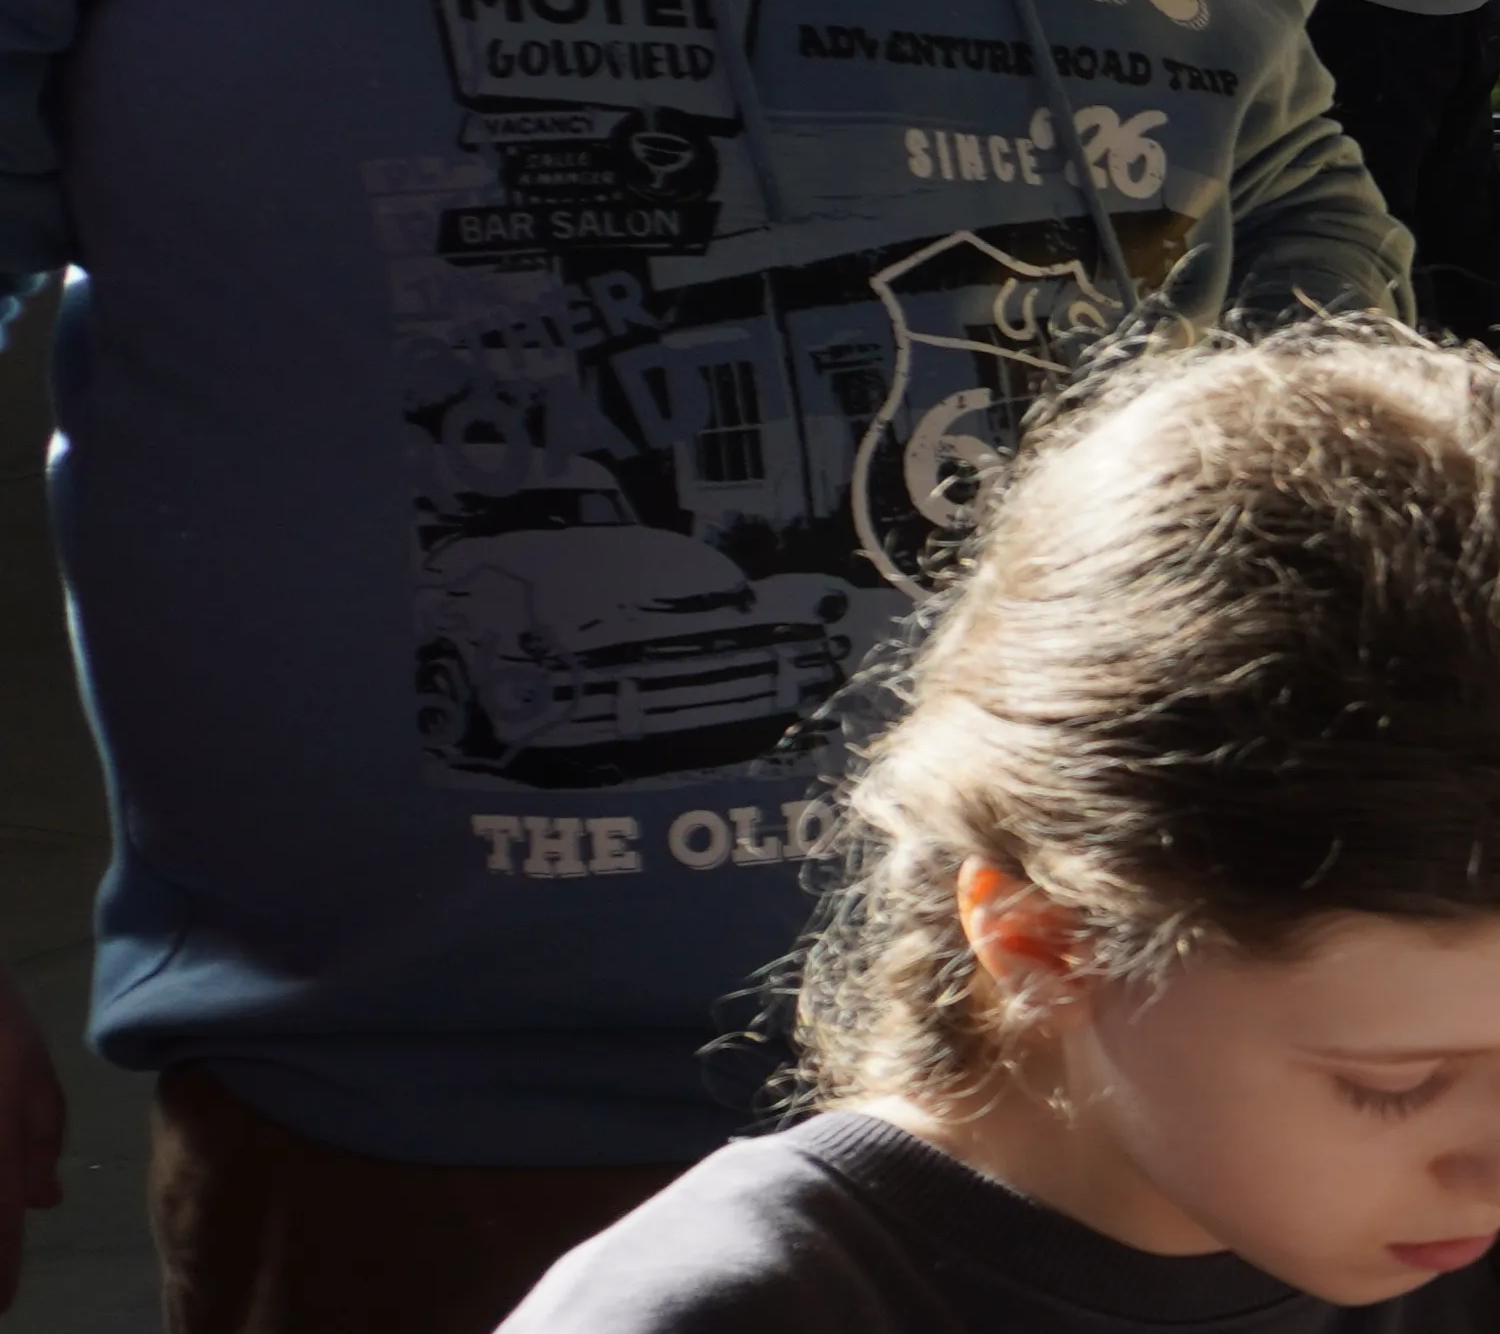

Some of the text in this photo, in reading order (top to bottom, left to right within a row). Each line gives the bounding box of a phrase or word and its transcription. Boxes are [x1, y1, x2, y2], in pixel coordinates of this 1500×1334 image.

[486, 38, 716, 82] GOLDFIELD
[1163, 56, 1240, 97] TRIP
[903, 127, 1046, 187] SINCE
[458, 212, 535, 246] BAR
[551, 207, 682, 240] SALON
[469, 813, 645, 879] THE
